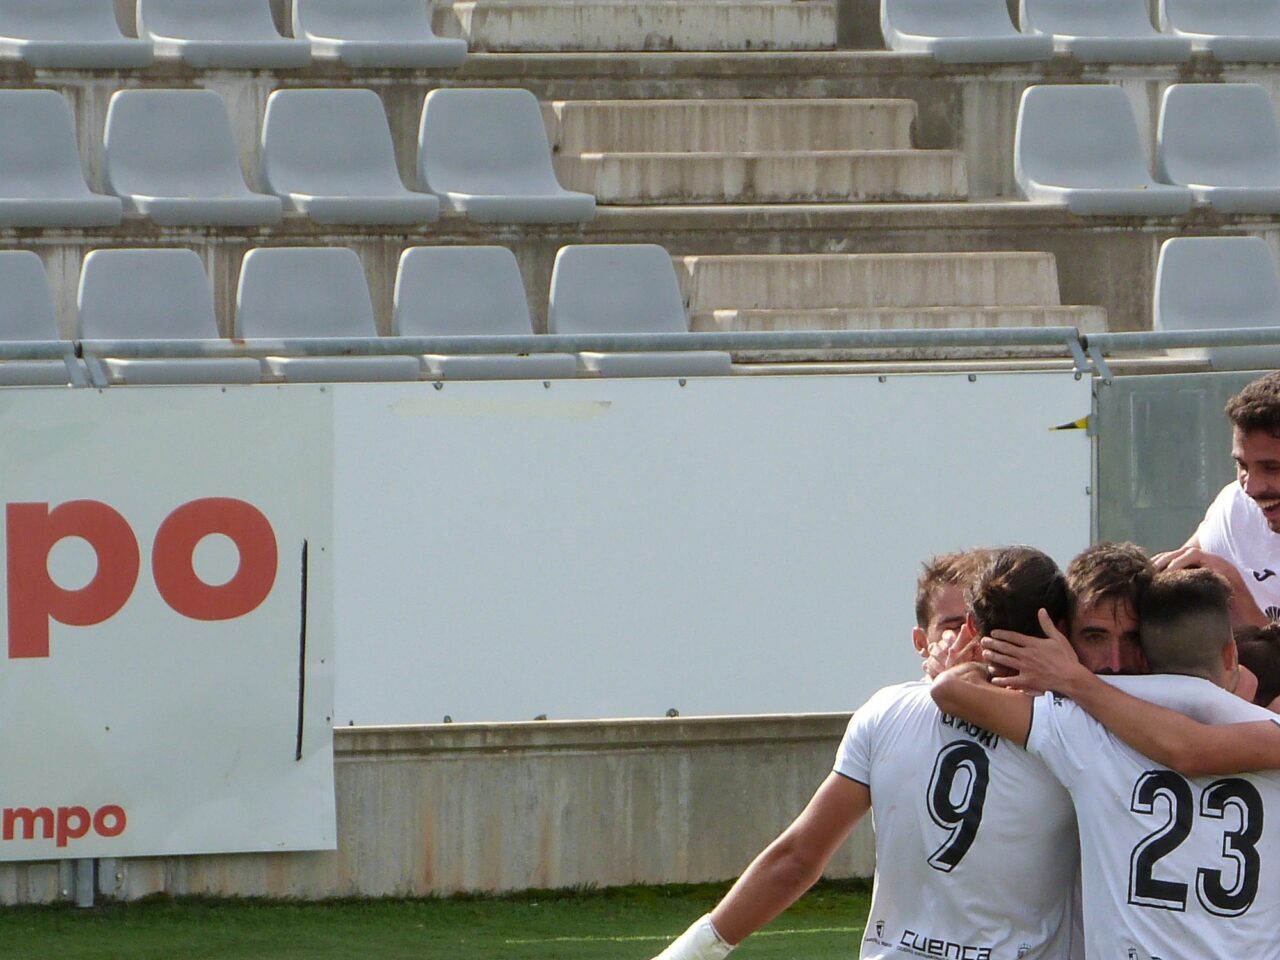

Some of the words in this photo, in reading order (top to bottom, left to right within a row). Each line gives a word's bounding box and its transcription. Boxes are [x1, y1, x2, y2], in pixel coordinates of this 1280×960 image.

[6, 497, 278, 658] po
[2, 804, 127, 848] mpo
[927, 740, 990, 872] 9
[1127, 770, 1264, 918] 23
